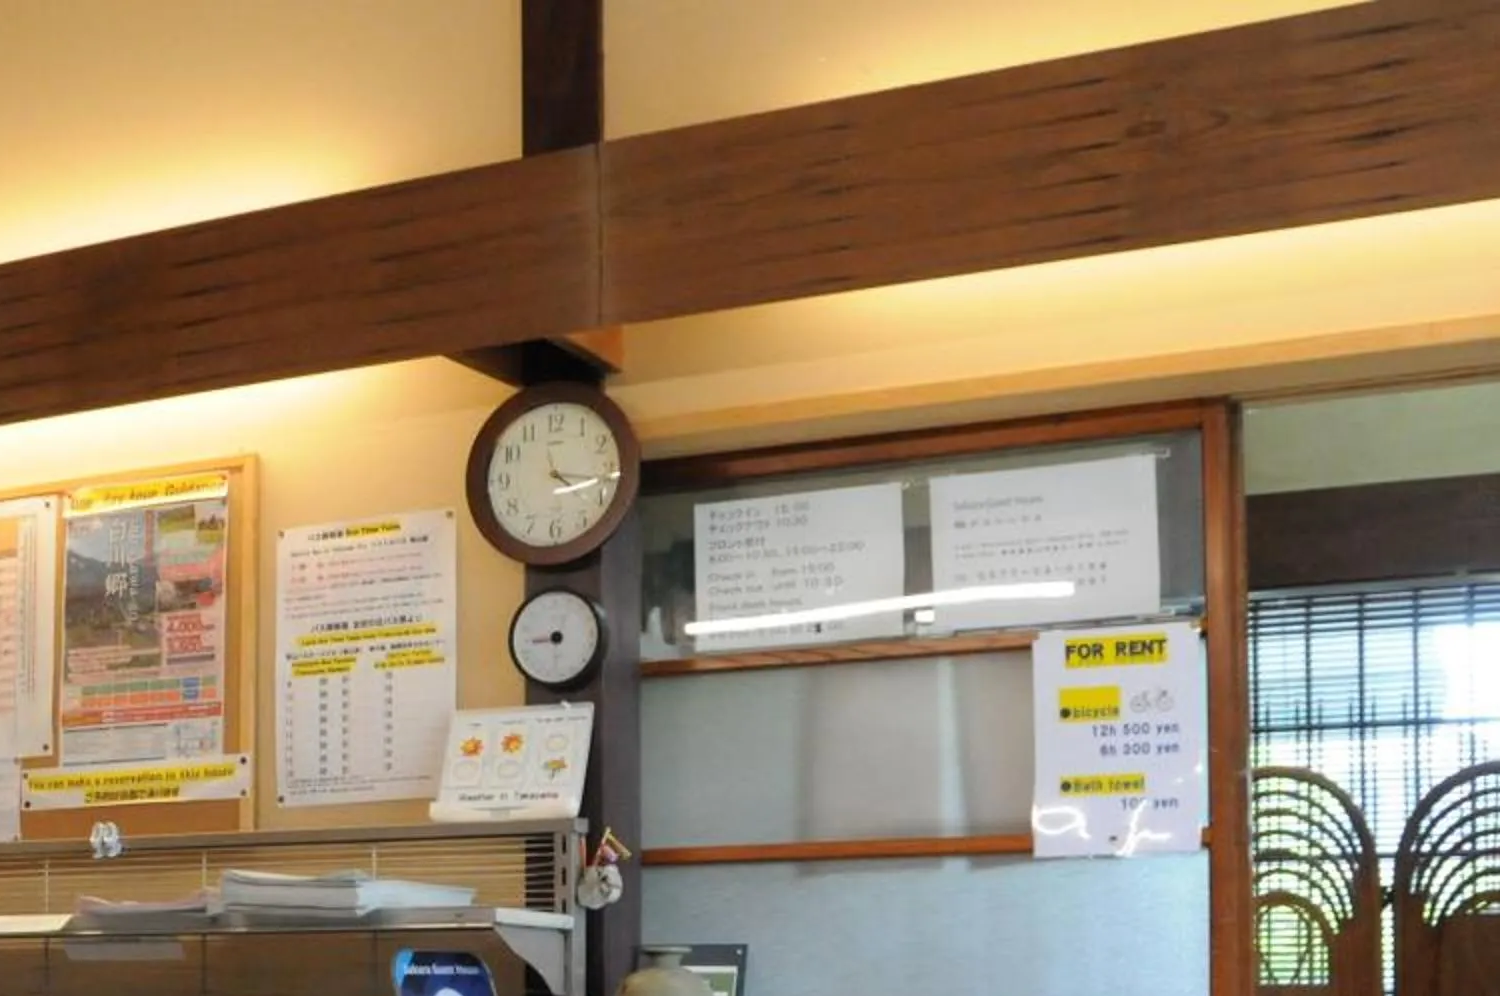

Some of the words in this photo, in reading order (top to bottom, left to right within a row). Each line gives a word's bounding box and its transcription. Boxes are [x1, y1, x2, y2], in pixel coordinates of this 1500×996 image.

[548, 413, 564, 433] 12
[522, 423, 535, 443] 11
[595, 434, 607, 454] 2
[504, 445, 521, 464] 10
[506, 499, 519, 516] 8
[525, 515, 536, 535] 7
[549, 515, 563, 538] 6
[1065, 642, 1104, 661] FOR
[1115, 638, 1167, 657] RENT
[1073, 705, 1120, 719] bicycle
[1092, 723, 1116, 737] 12h
[1123, 722, 1150, 735] 500
[1156, 723, 1179, 736] yen
[1156, 743, 1180, 755] yen
[1109, 775, 1145, 791] towel
[1153, 797, 1179, 809] yen
